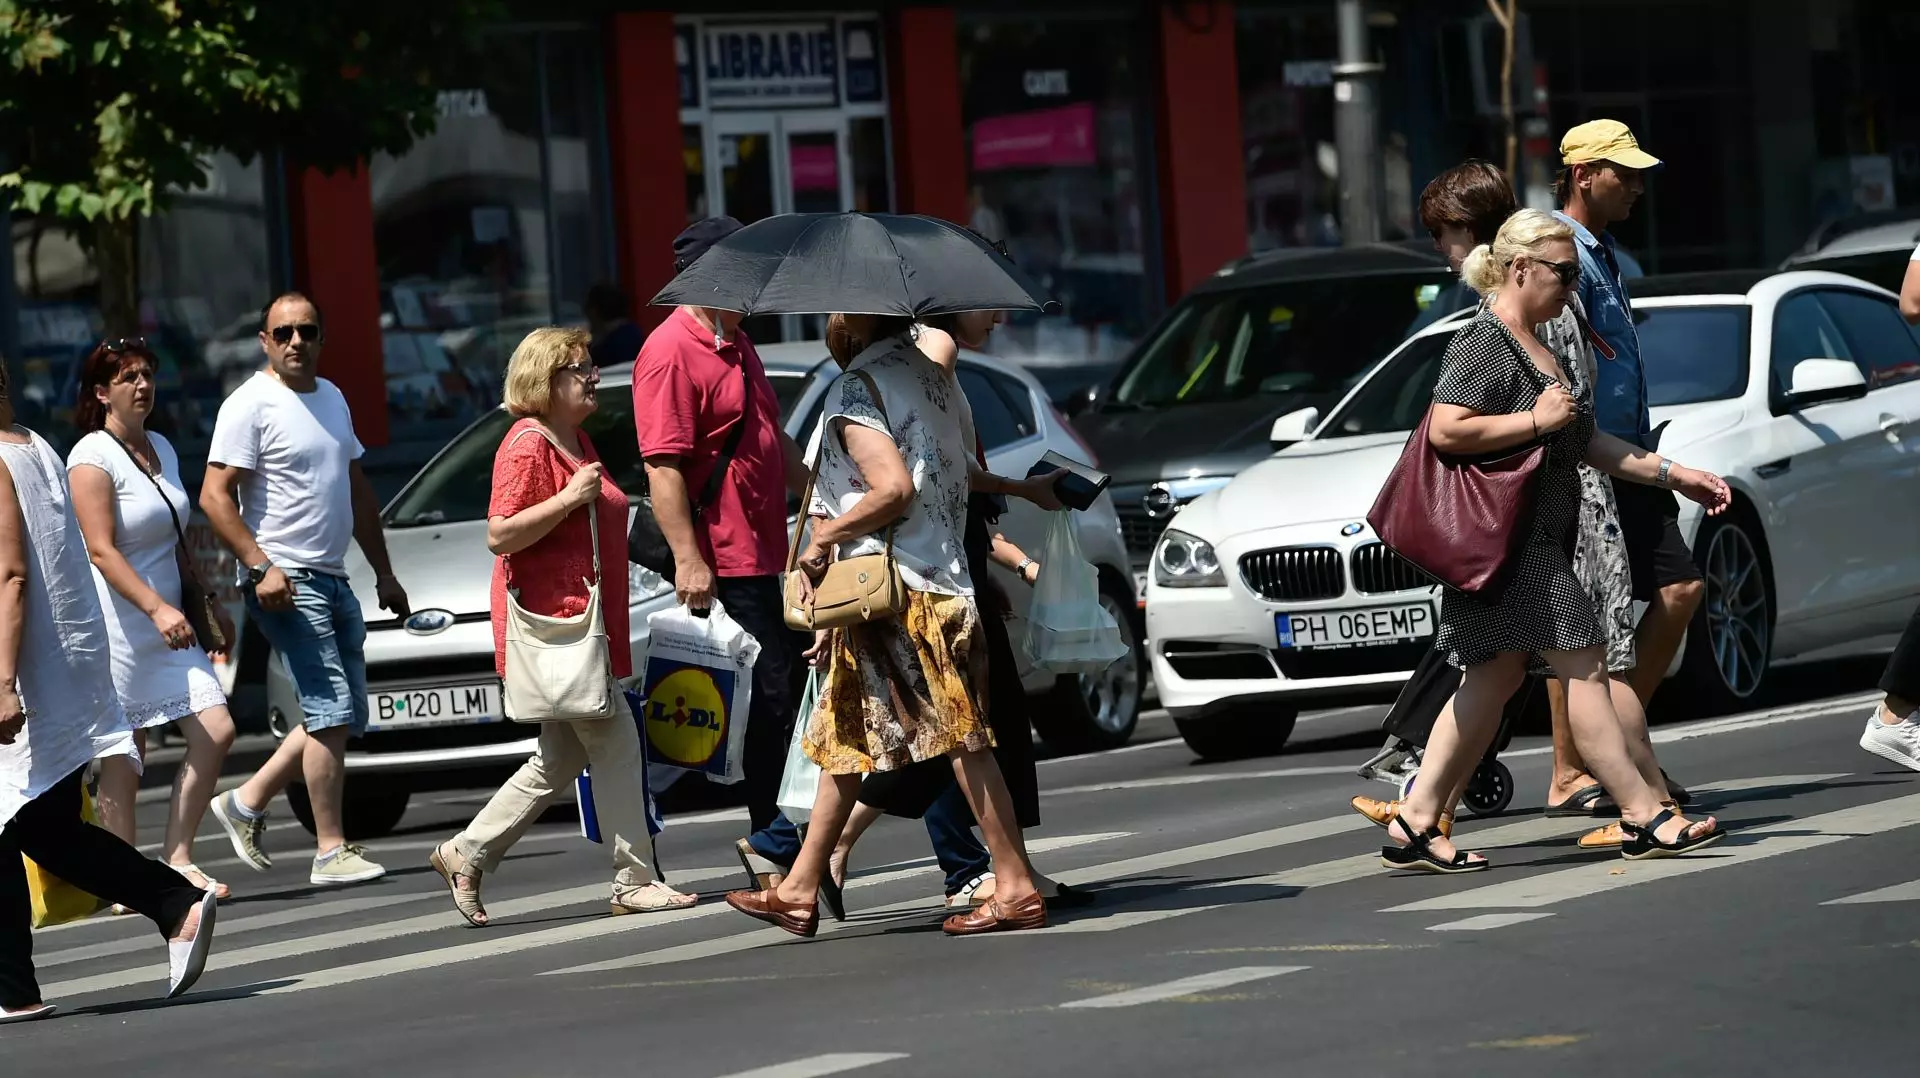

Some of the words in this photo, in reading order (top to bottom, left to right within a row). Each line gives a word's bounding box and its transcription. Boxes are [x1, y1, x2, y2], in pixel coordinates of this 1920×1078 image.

[704, 31, 832, 78] LIBRARIE
[1290, 615, 1329, 643] PH
[377, 695, 395, 720] B
[403, 692, 441, 718] 120
[450, 687, 488, 715] LMI
